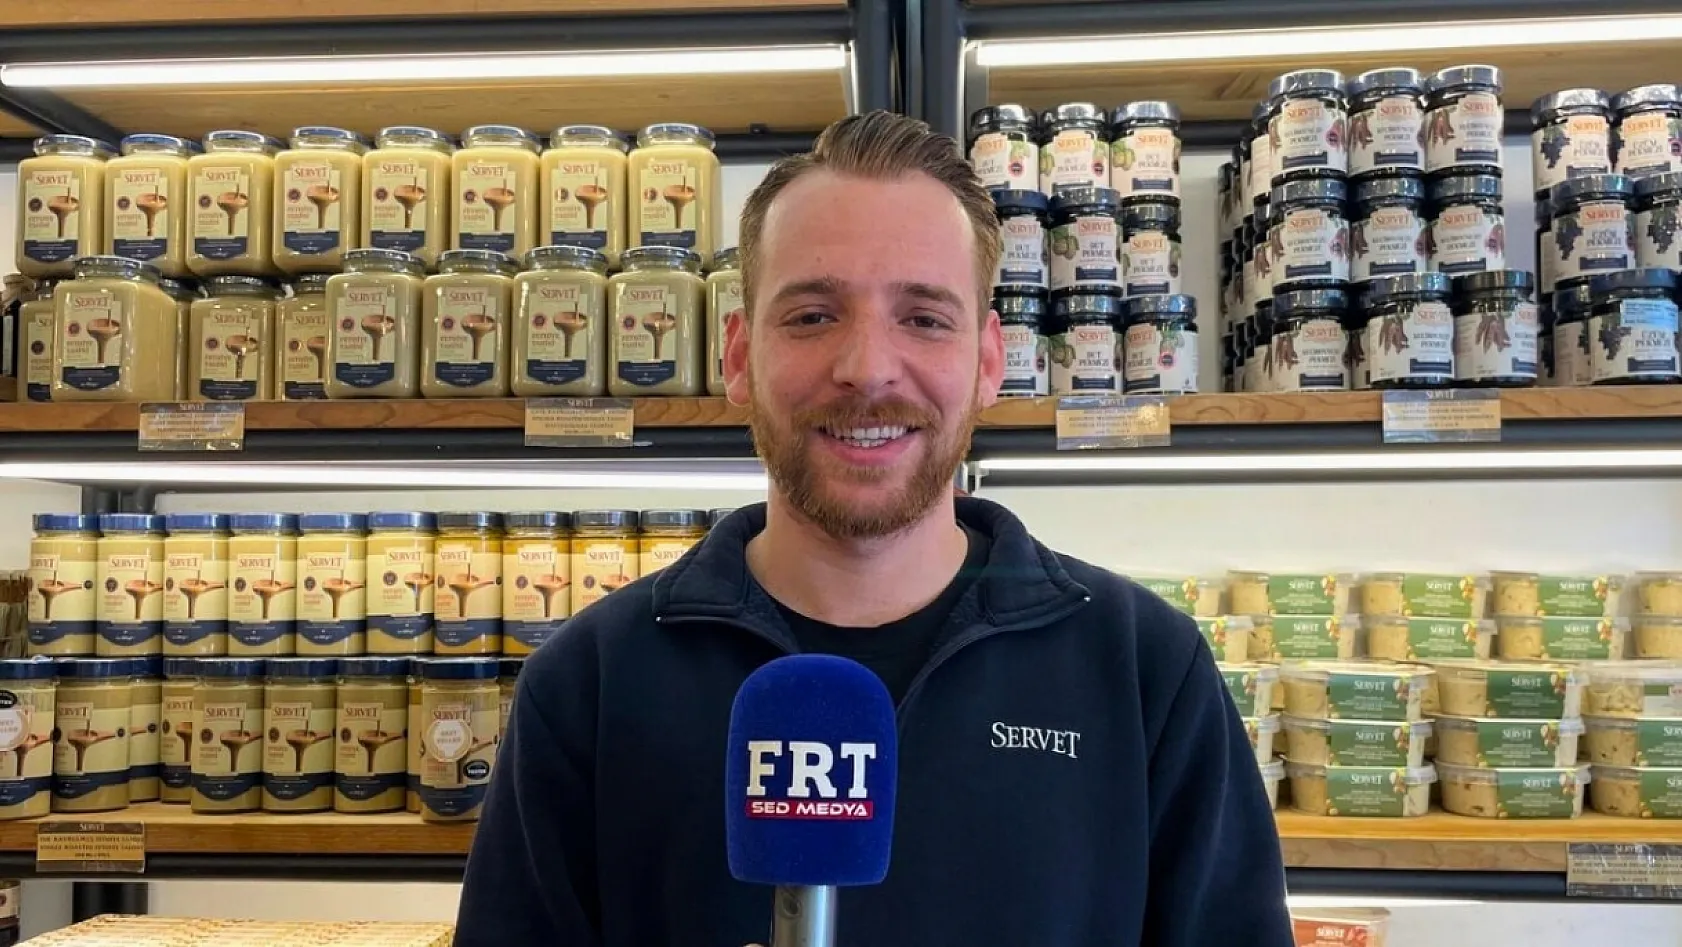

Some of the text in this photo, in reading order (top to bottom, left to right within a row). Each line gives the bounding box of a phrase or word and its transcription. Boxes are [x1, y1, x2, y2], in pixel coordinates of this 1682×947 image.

[1354, 680, 1385, 690] SERVET
[1512, 677, 1542, 687] SERVET
[1356, 732, 1385, 741] SERVET
[1503, 729, 1532, 739] SERVET
[991, 721, 1080, 758] SERVET
[746, 740, 876, 798] FRT
[1351, 775, 1383, 785] SERVET
[1522, 778, 1550, 787] SERVET
[752, 802, 867, 816] SED MEDYA
